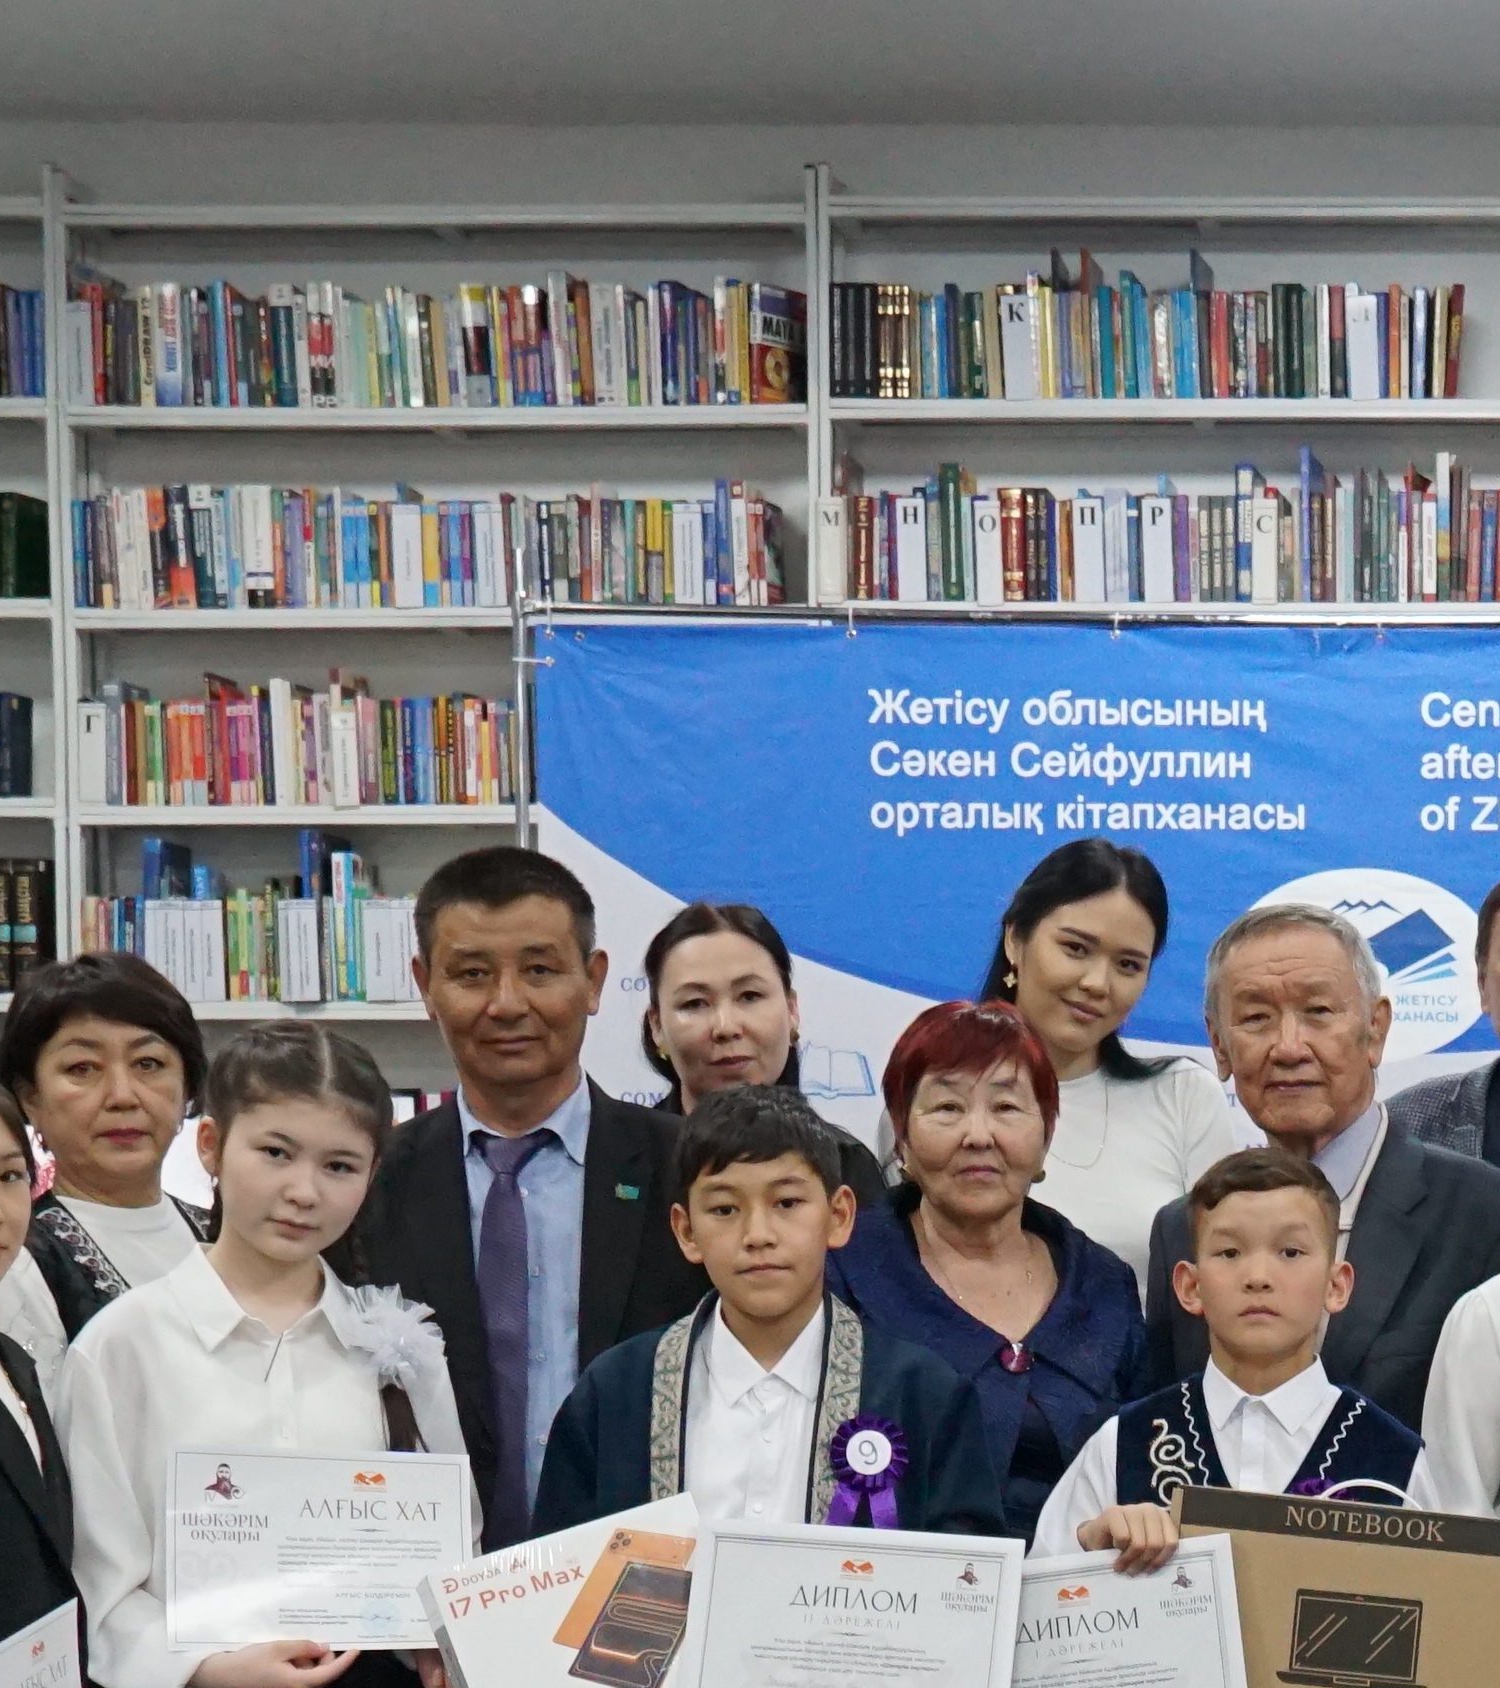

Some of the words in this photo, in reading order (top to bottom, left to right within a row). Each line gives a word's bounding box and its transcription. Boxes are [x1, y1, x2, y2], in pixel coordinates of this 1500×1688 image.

[868, 689, 1009, 734] Жетісу
[1023, 690, 1267, 733] облысының
[869, 740, 997, 778] Сәкен
[1010, 740, 1252, 786] Сейфуллин
[869, 799, 1044, 836] орталық
[1056, 794, 1306, 831] кітапханасы
[1420, 796, 1461, 831] of
[1394, 1012, 1459, 1023] ХАНАСЫ
[1395, 995, 1458, 1006] ЖЕТІСУ
[396, 1500, 442, 1522] ХАТ
[1285, 1505, 1446, 1542] NOTEBOOK
[479, 1585, 526, 1609] Pro
[530, 1566, 585, 1593] Max
[788, 1584, 918, 1615] ДИПЛОМ
[1015, 1606, 1140, 1645] ДИПЛОМ
